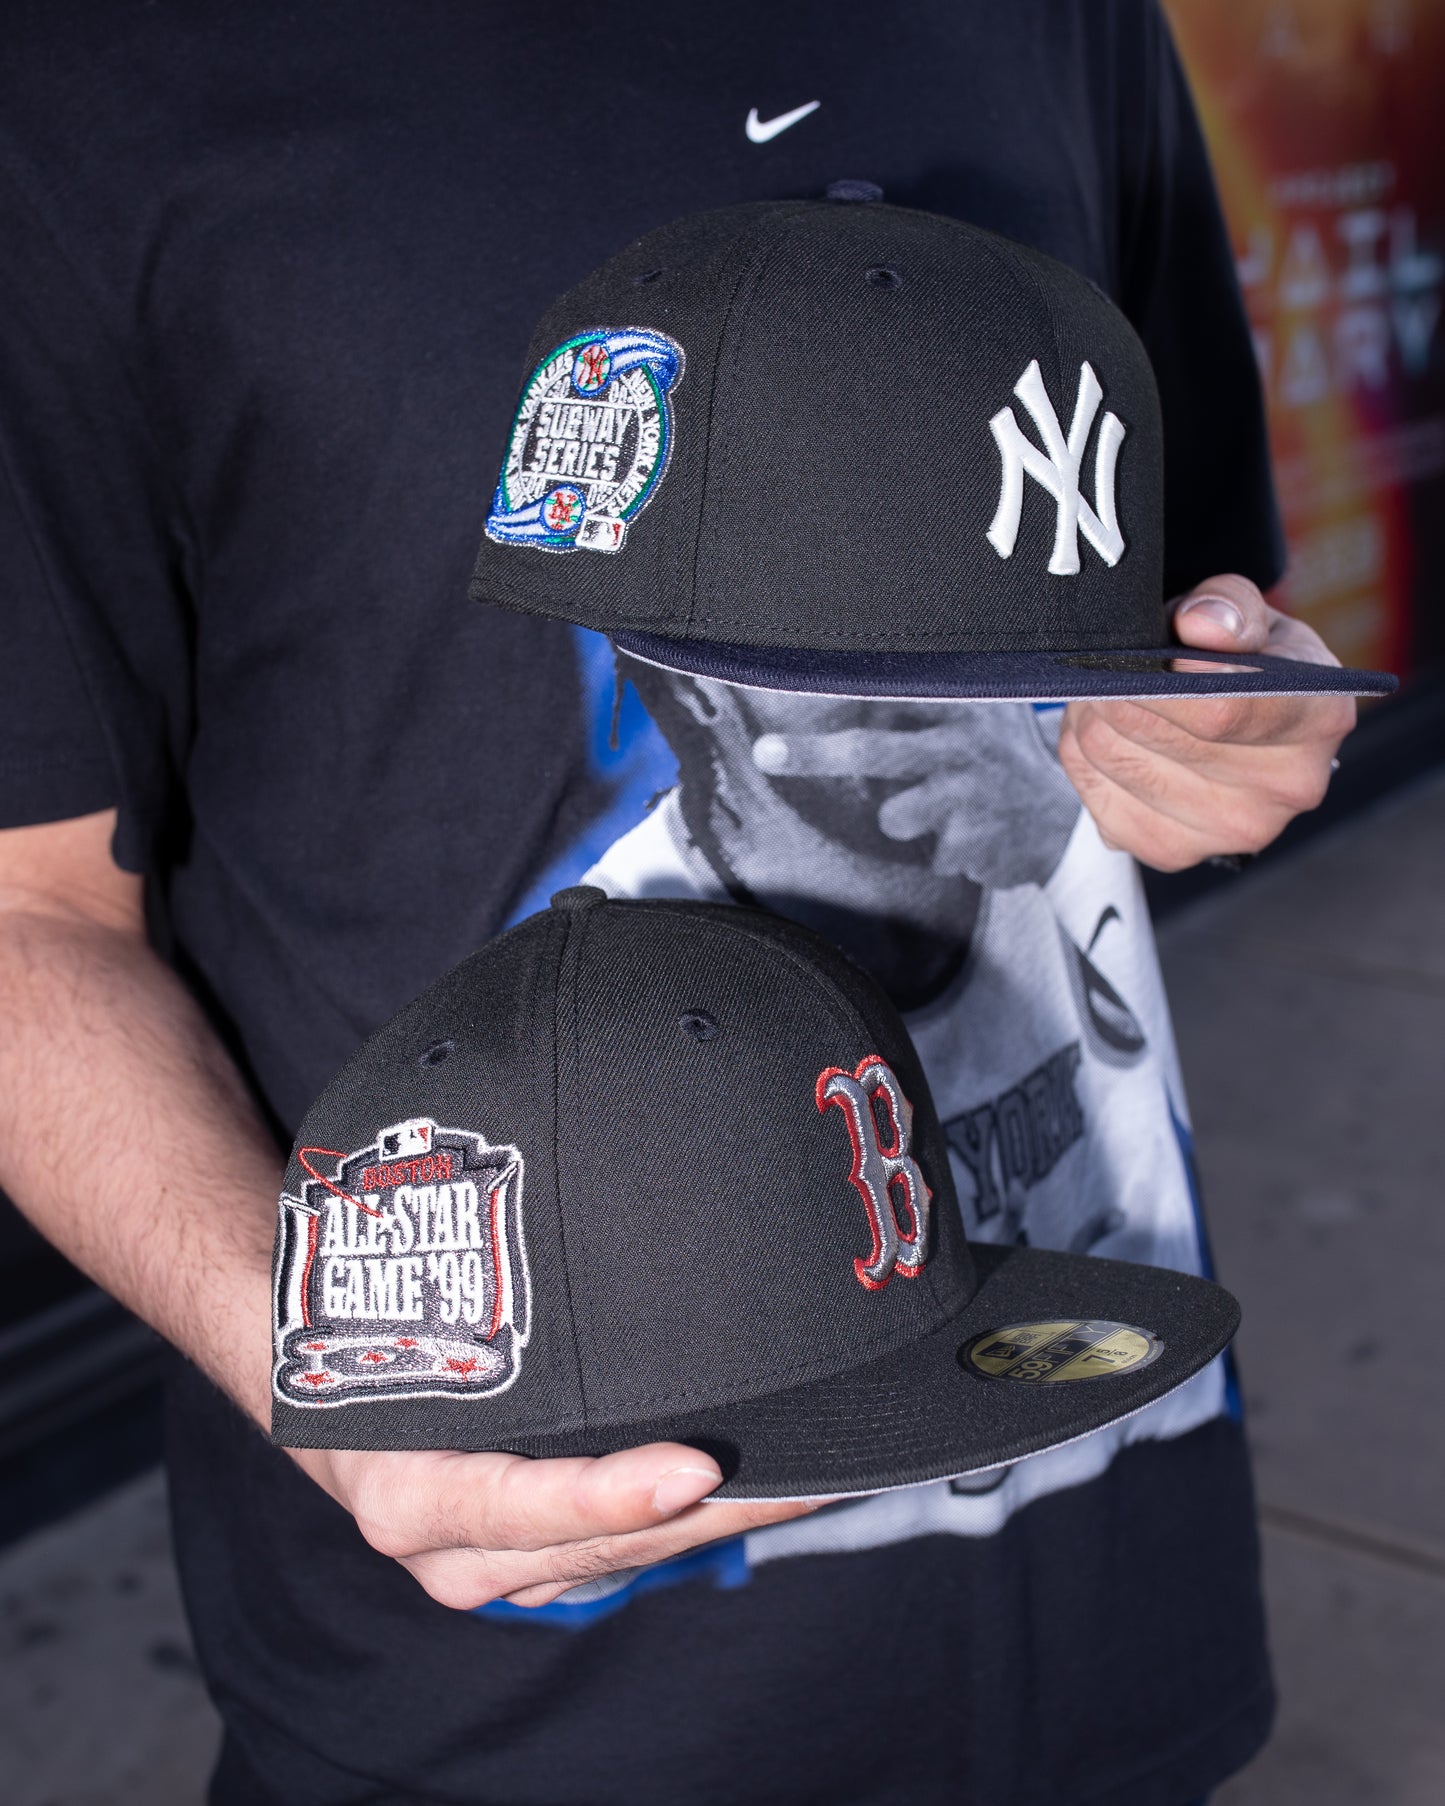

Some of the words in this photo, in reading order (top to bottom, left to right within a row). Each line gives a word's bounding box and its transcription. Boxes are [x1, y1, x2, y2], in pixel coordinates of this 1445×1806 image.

[535, 403, 633, 444] SUBWAY
[640, 413, 661, 472] YORK
[529, 438, 621, 481] SERIES
[986, 359, 1127, 576] NY
[941, 1038, 1084, 1226] YORK
[363, 1153, 452, 1190] BOSTON
[816, 1055, 933, 1290] B
[322, 1256, 424, 1321] GAME
[427, 1251, 484, 1324] '99
